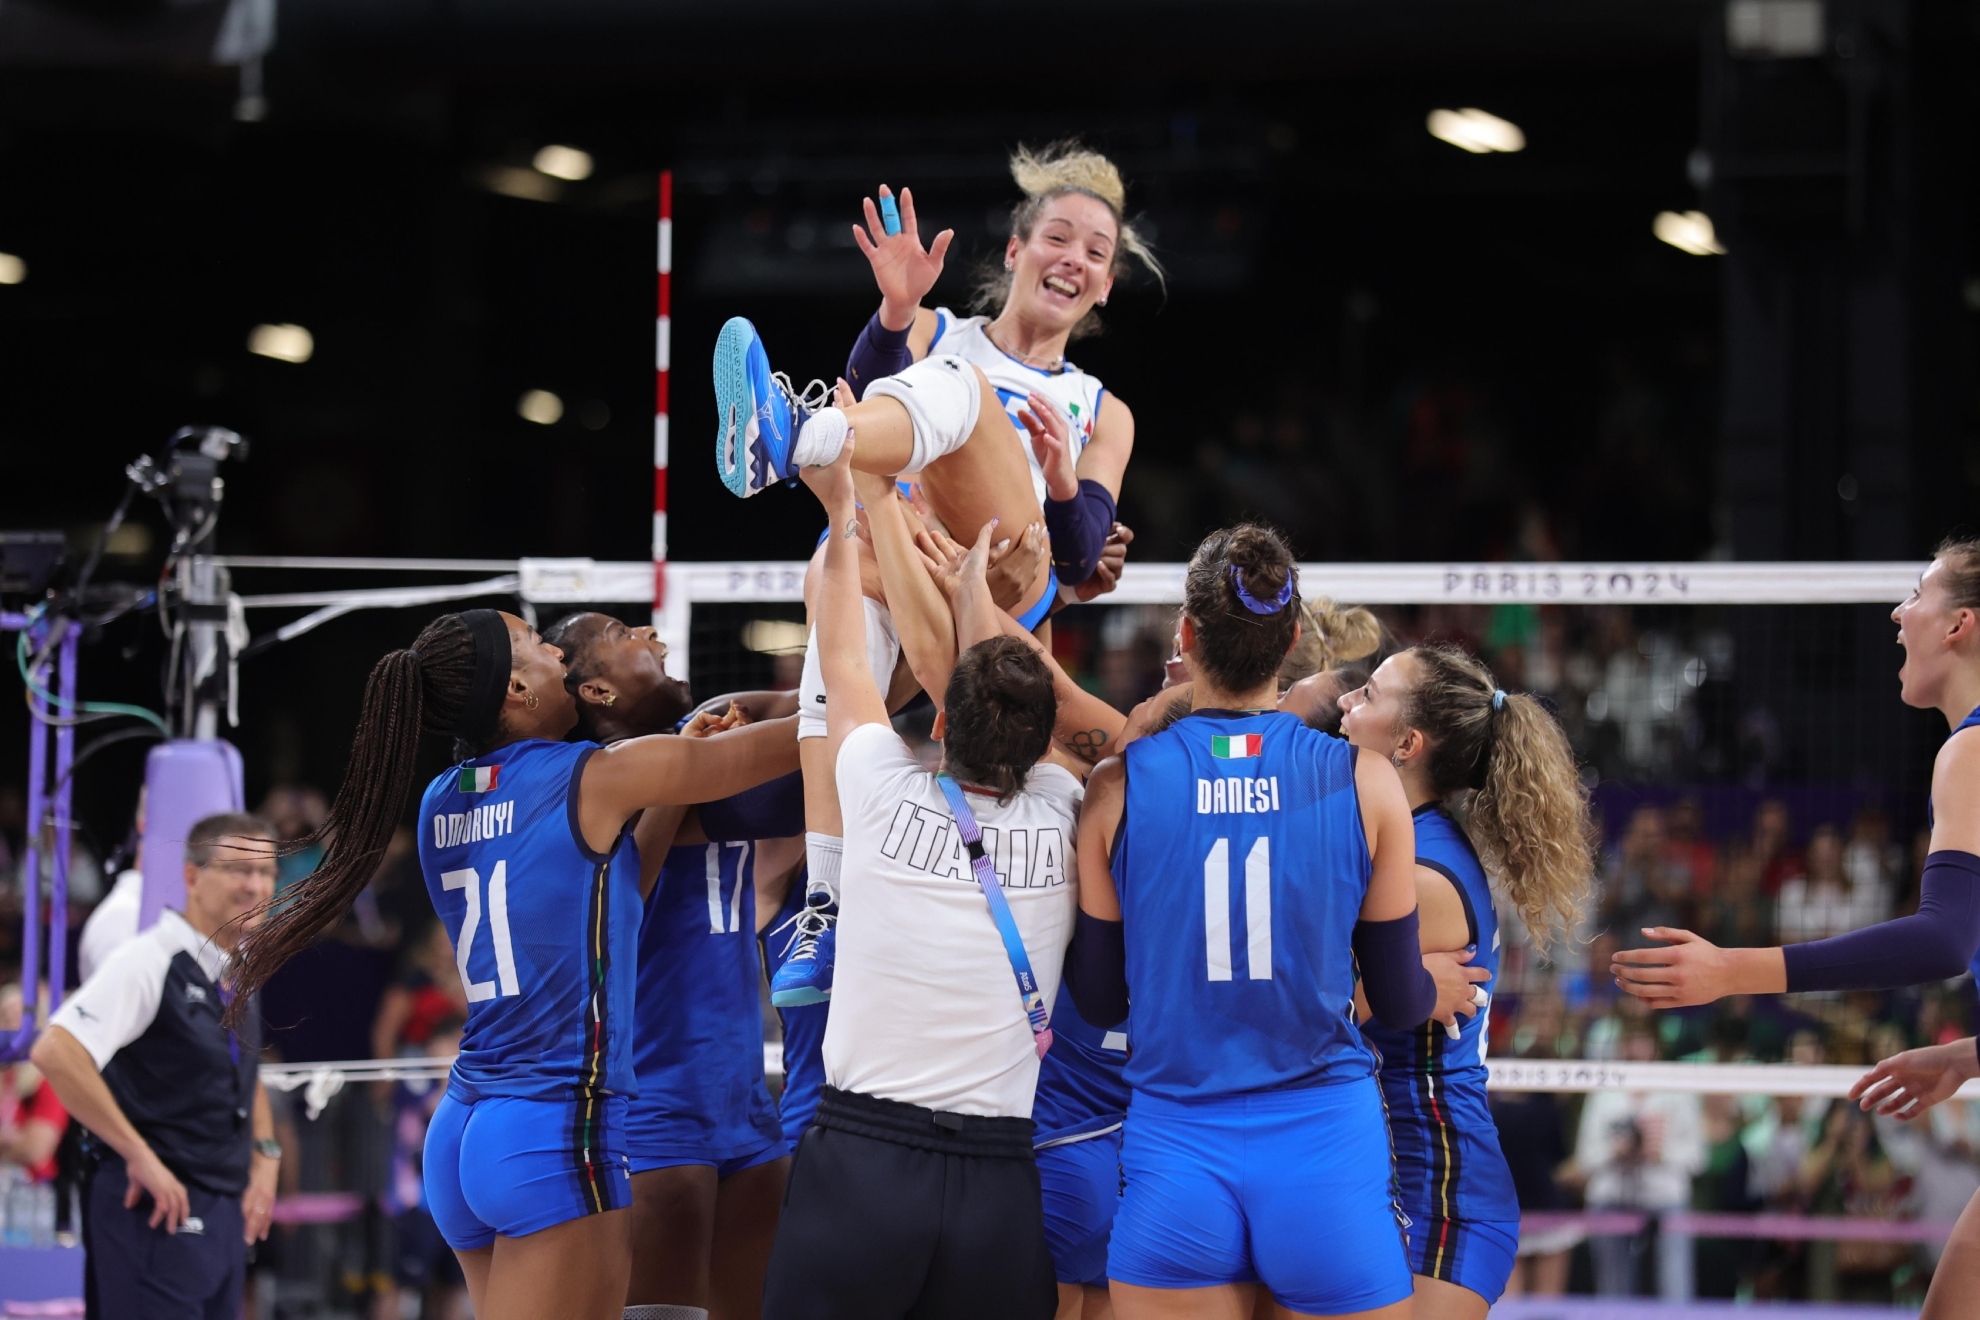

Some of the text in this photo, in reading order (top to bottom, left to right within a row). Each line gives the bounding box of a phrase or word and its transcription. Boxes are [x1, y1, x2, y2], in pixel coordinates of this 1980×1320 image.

[1444, 572, 1688, 597] PARIS 2024
[433, 800, 515, 850] OMORUYI
[1197, 776, 1280, 814] DANESI
[705, 840, 750, 935] 17
[880, 799, 1066, 889] ITALIA
[440, 860, 521, 1003] 21
[1204, 836, 1272, 982] 11
